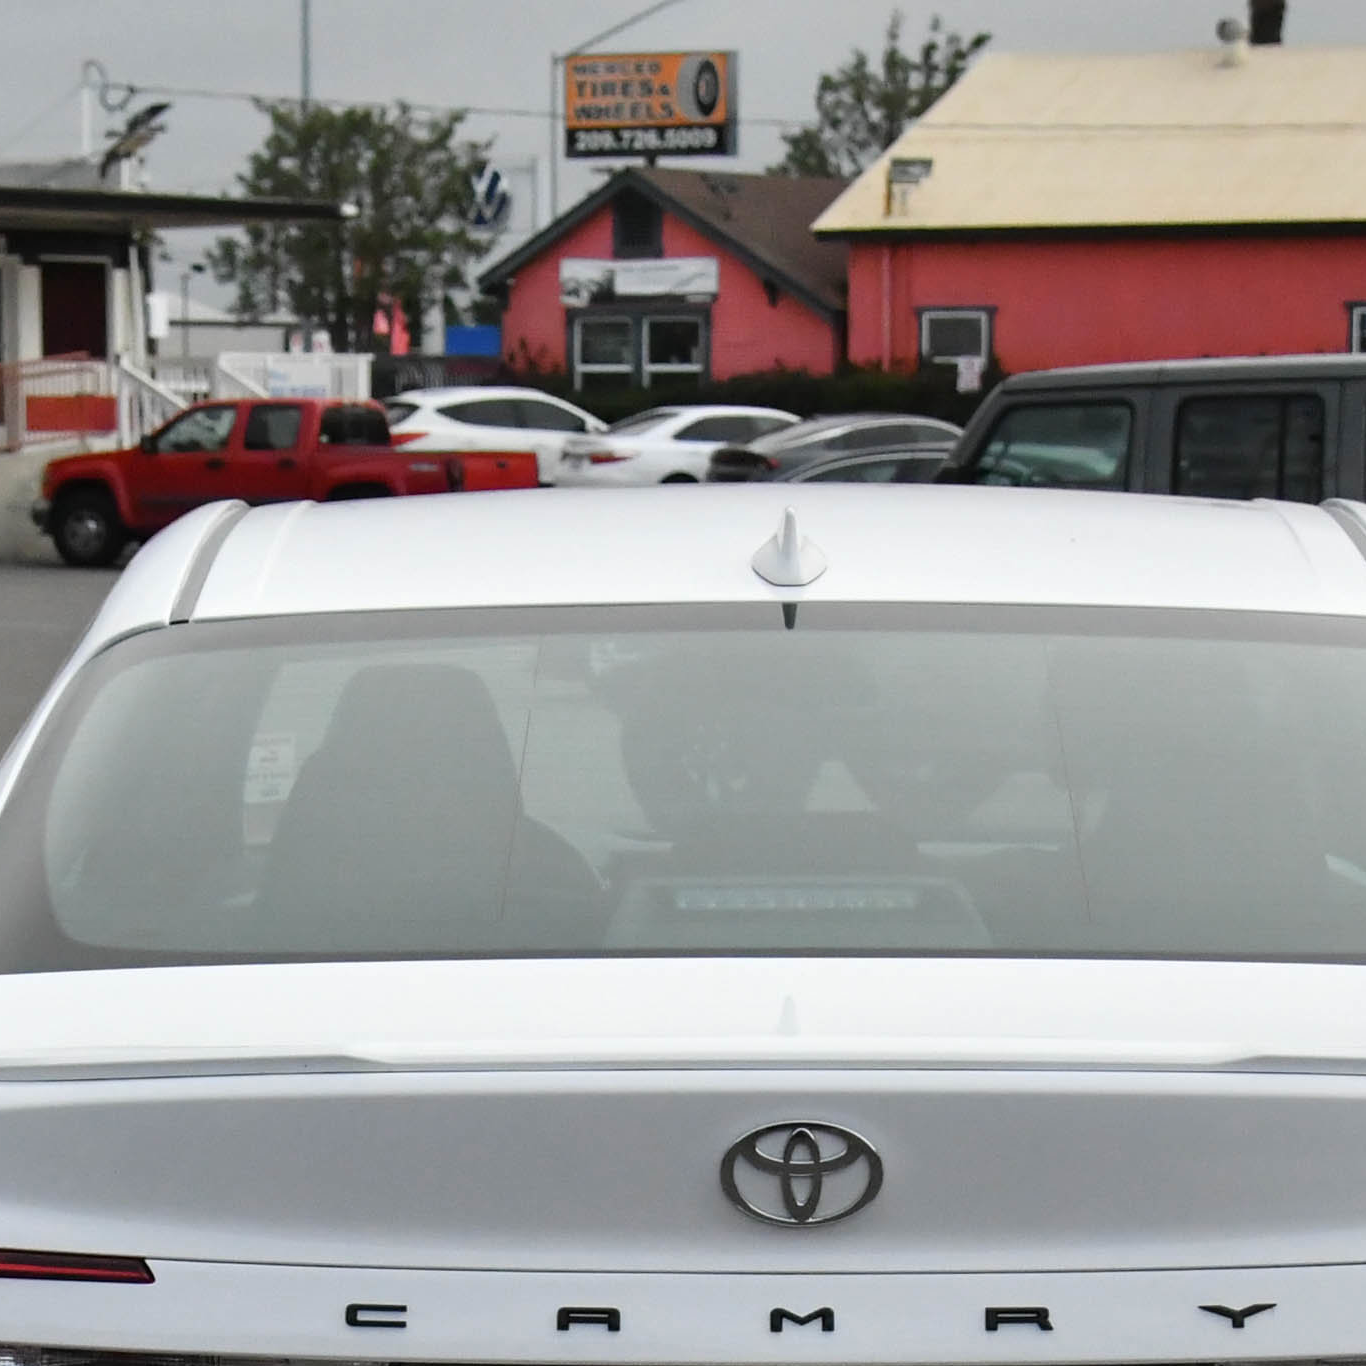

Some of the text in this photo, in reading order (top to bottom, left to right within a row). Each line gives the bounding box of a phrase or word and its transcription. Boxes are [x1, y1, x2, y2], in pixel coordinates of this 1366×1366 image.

[572, 61, 661, 75] MERCED
[576, 79, 653, 97] TIRES
[574, 102, 674, 120] WHEELS
[345, 1302, 1278, 1332] CAMRY
